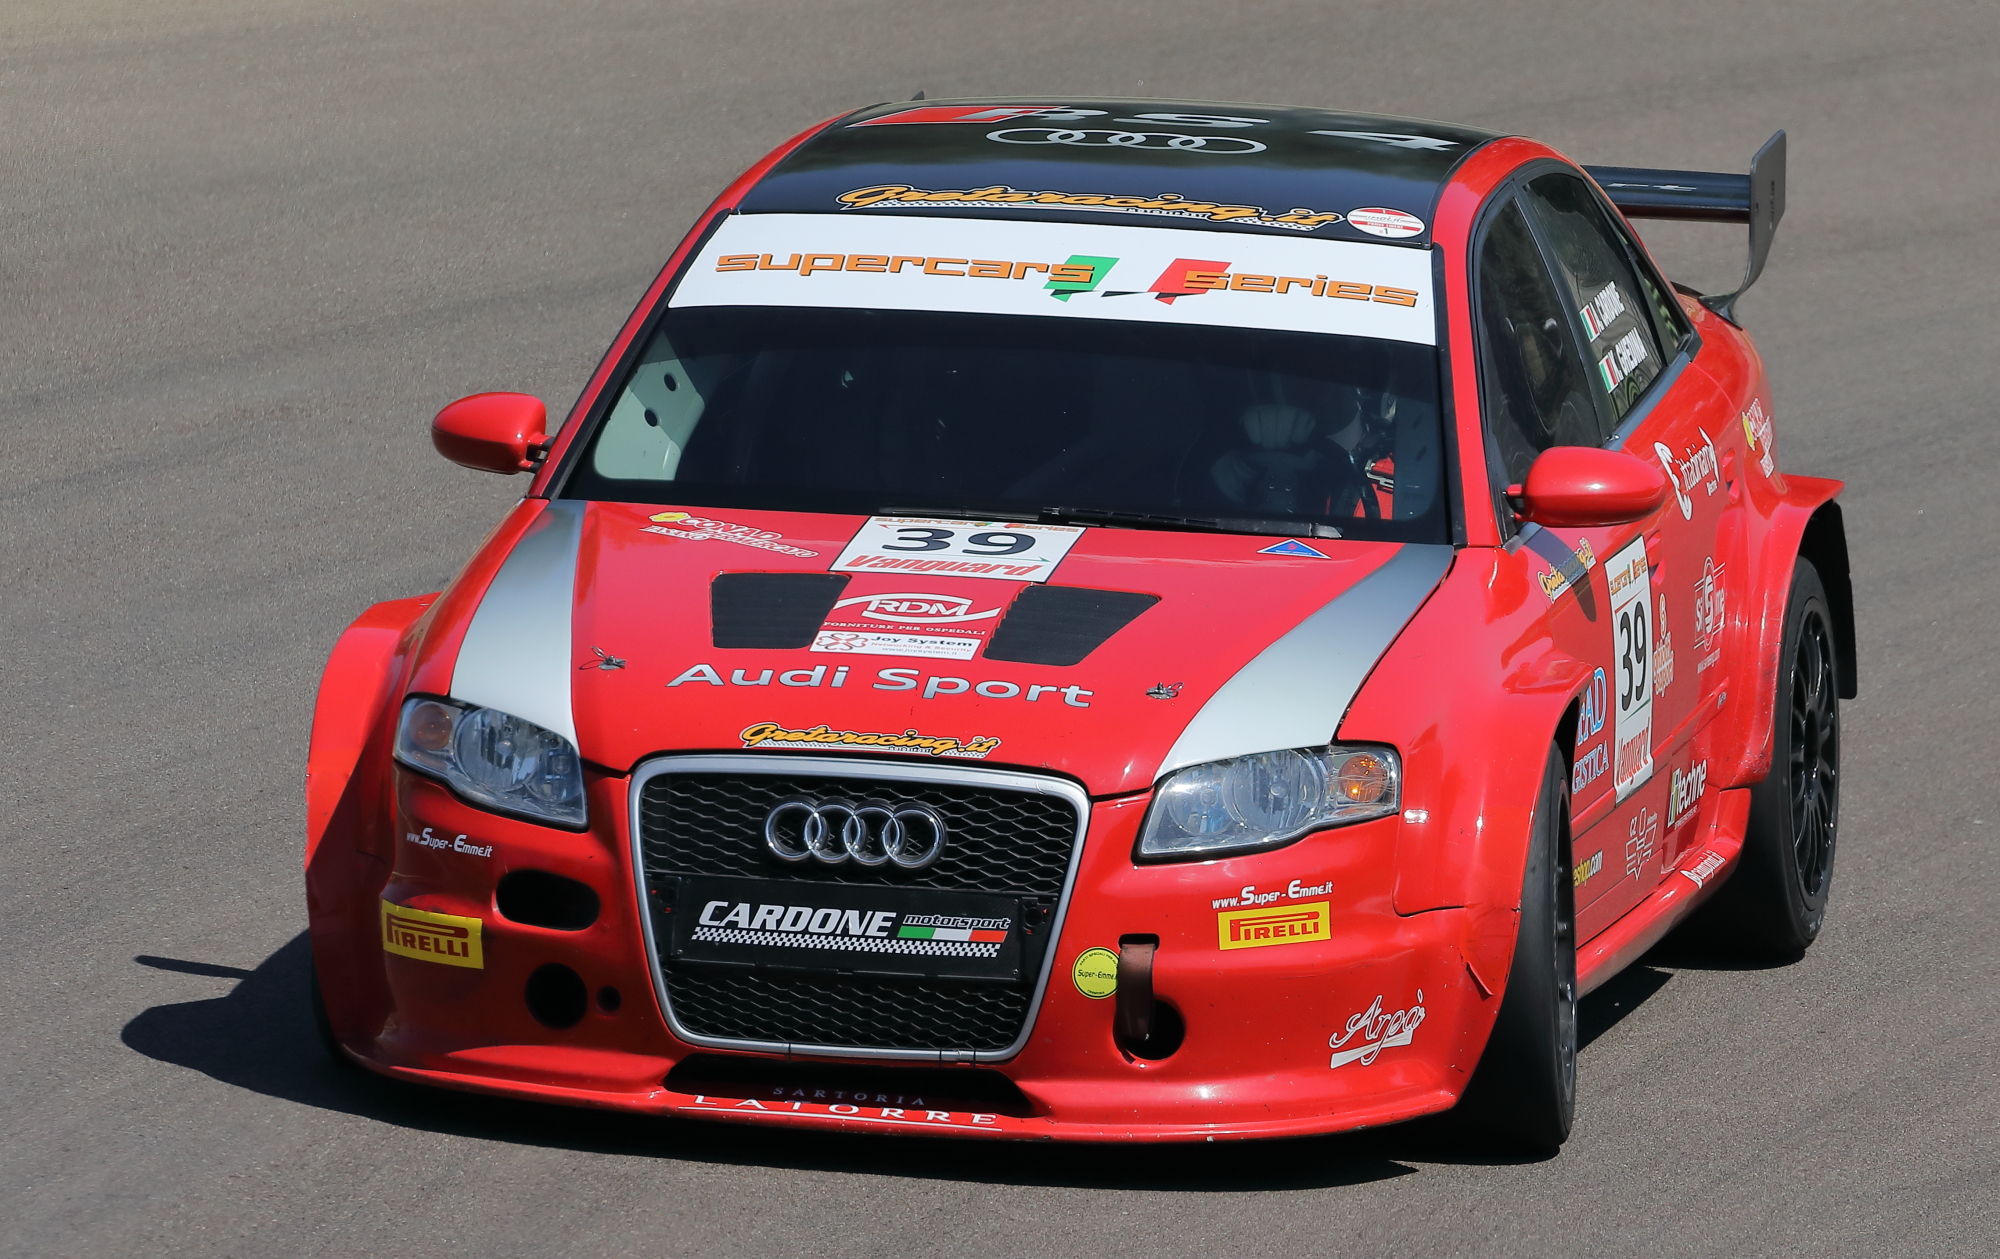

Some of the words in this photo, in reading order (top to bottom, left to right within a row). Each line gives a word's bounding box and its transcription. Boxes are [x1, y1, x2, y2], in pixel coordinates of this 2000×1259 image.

[838, 184, 1343, 227] Gretaracing.it
[715, 253, 1095, 284] supercars
[1183, 269, 1419, 308] series
[678, 517, 783, 541] CONAD
[873, 516, 988, 528] supercars
[881, 527, 1037, 556] 39
[844, 554, 1044, 577] Vanguard
[866, 599, 970, 617] RDM
[823, 621, 894, 631] FORNITURE
[925, 626, 987, 636] OSPEDALI
[870, 636, 902, 644] Joy
[906, 637, 974, 647] System
[1619, 600, 1648, 711] 39
[664, 663, 850, 688] Audi
[871, 667, 1095, 709] Sport
[742, 723, 1000, 756] Gretaracing.it
[1571, 740, 1610, 795] GISTICA
[698, 900, 898, 937] CARDONE
[902, 913, 1013, 930] motorsport
[1229, 911, 1321, 942] PIRELLI
[385, 912, 470, 958] PIRELLI
[1077, 969, 1117, 980] Super-Emme.
[694, 1094, 997, 1125] LATORRE
[773, 1086, 925, 1106] SARTORIA
